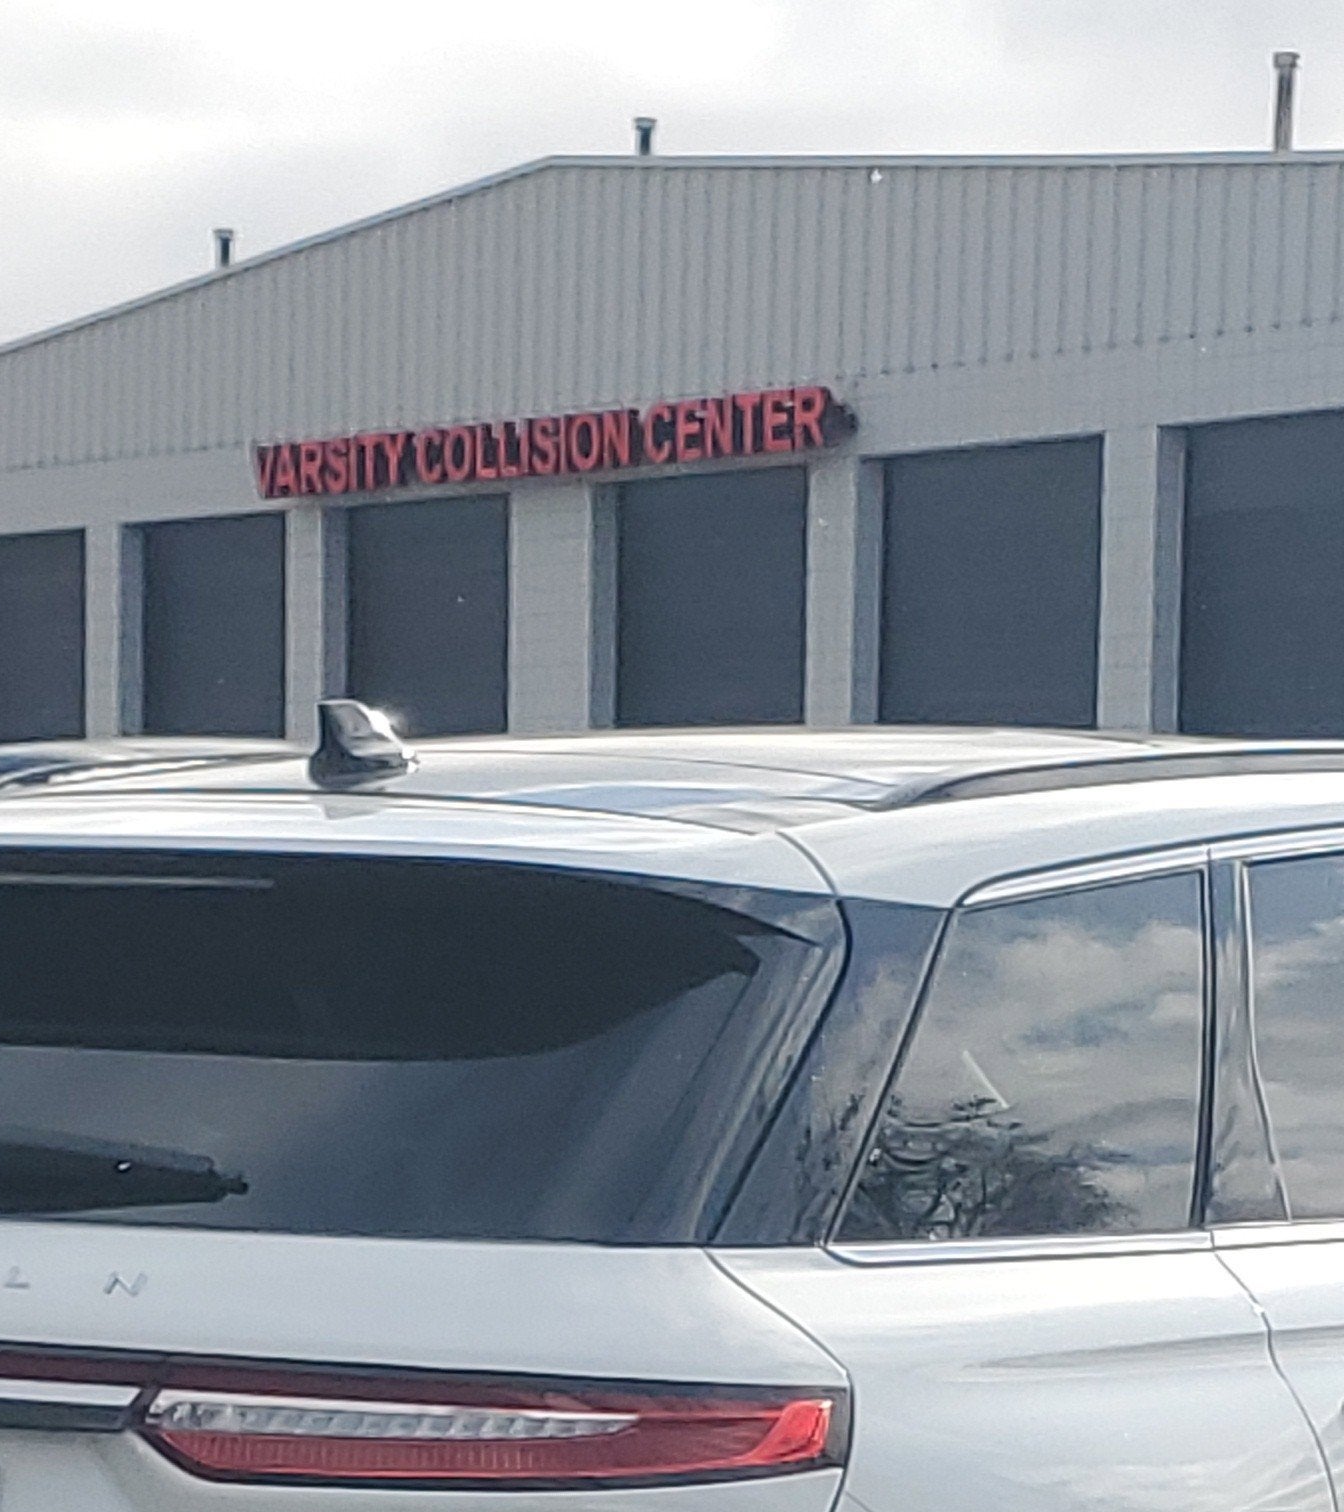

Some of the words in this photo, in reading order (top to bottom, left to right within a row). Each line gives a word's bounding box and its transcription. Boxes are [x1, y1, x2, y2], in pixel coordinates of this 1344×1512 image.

[256, 432, 413, 497] VARSITY
[414, 410, 633, 482] COLLISION
[642, 385, 829, 463] CENTER
